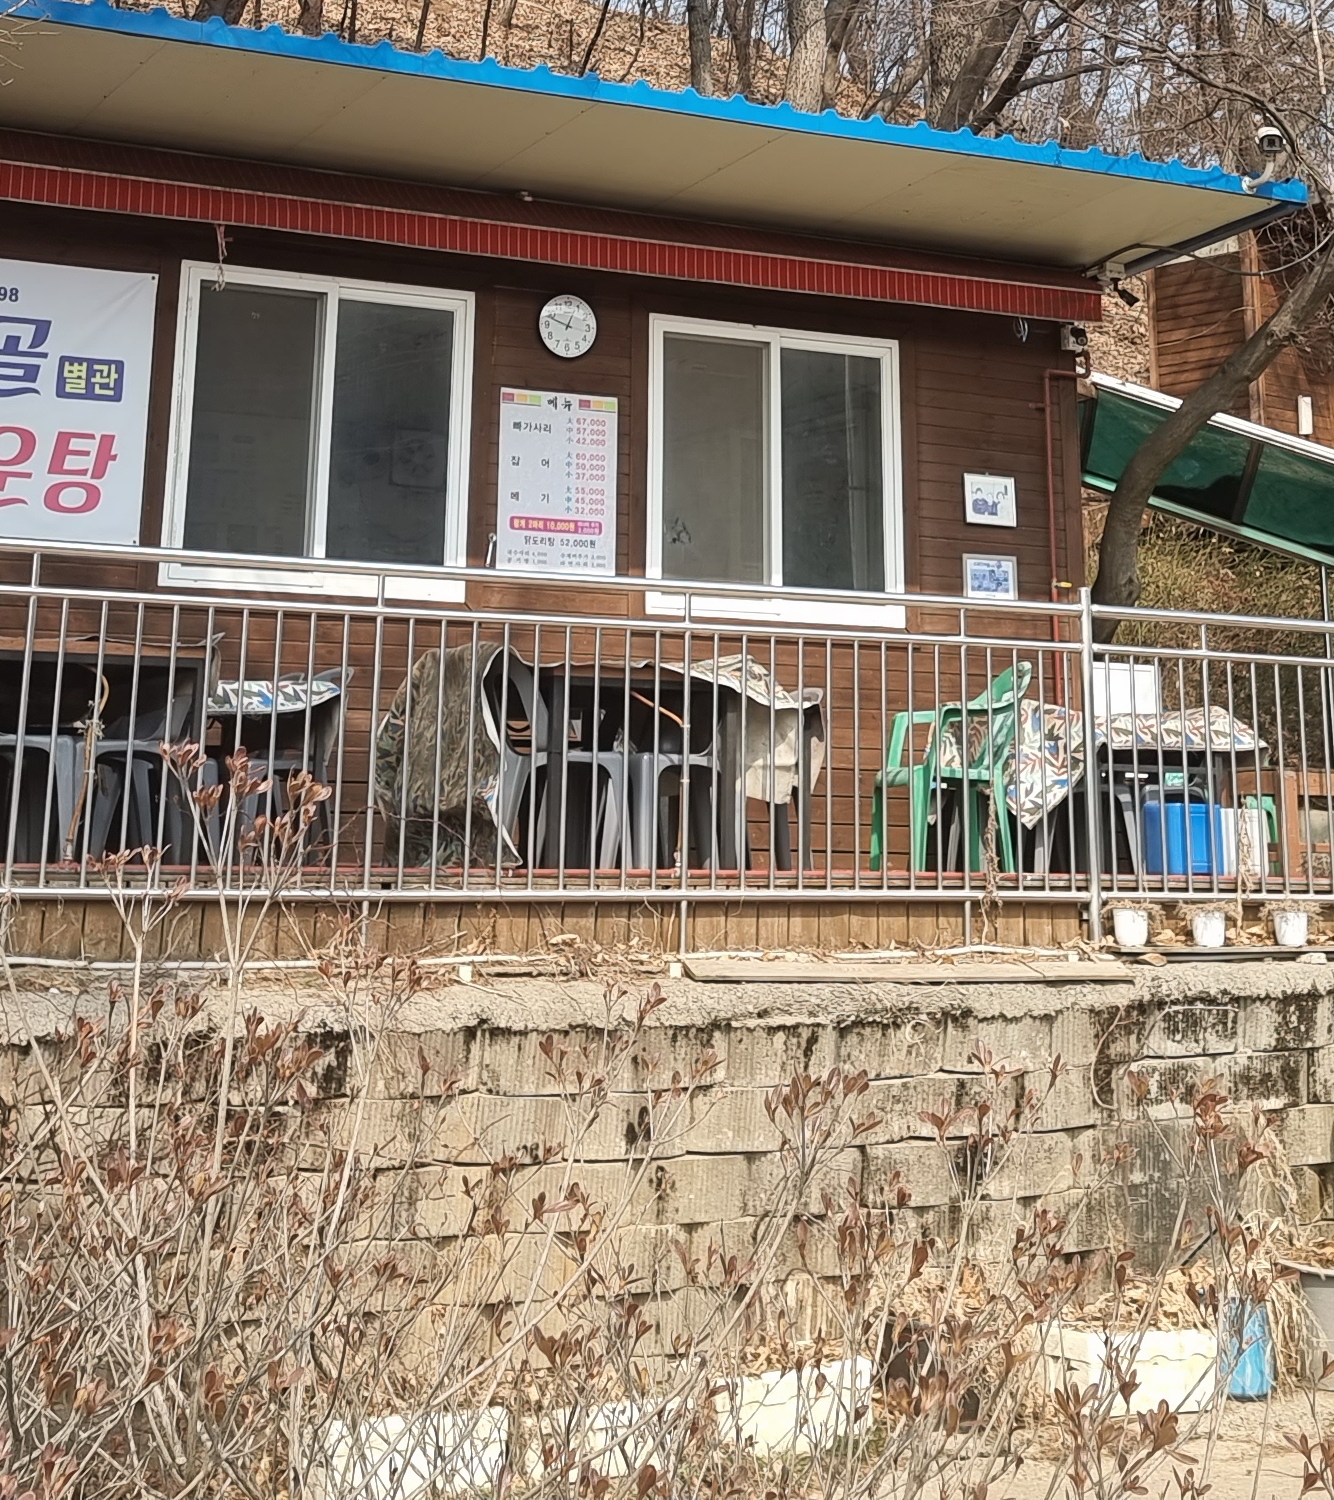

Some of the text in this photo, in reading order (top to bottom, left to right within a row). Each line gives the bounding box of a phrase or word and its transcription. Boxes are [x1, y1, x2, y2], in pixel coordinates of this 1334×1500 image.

[545, 320, 550, 329] 9
[585, 324, 590, 332] 3
[555, 340, 560, 348] 7
[564, 343, 569, 351] 6
[575, 341, 580, 350] 5
[63, 361, 118, 396] 별관
[547, 396, 573, 412] 메뉴
[512, 421, 552, 434] 빠가사리
[575, 418, 607, 428] 67,000
[575, 428, 606, 437] 57,000
[575, 438, 606, 446] 42,000
[575, 452, 606, 462] 60,000
[575, 462, 605, 472] 50,000
[575, 472, 605, 482] 37,000
[575, 486, 605, 496] 55,000
[575, 497, 605, 506] 45,000
[575, 506, 605, 516] 32,000
[524, 535, 597, 548] 닭도리탕 52,000원
